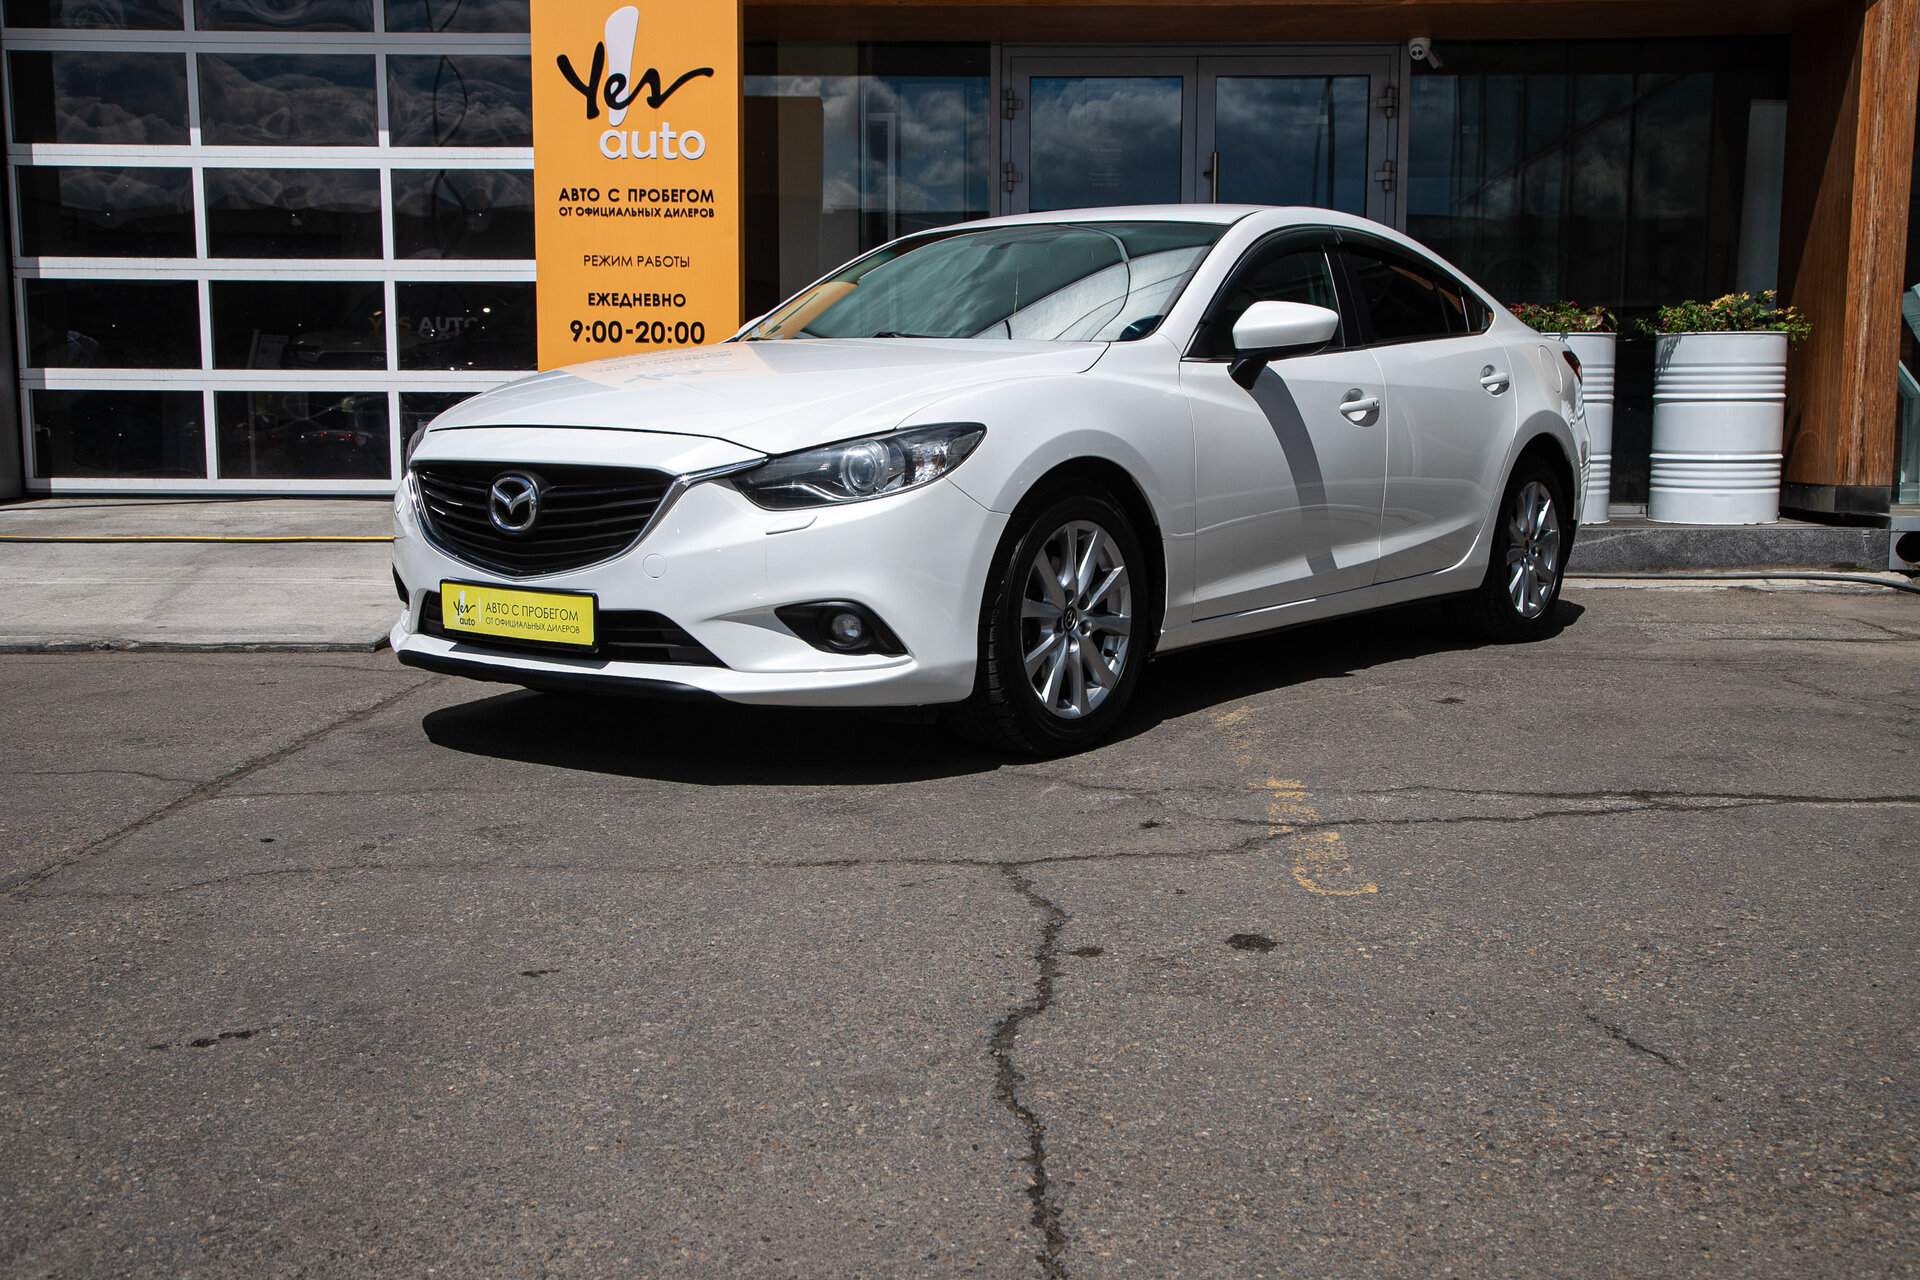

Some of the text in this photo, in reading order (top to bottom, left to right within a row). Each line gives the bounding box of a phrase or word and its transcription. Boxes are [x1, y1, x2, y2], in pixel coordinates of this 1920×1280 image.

[599, 122, 706, 160] auto
[559, 188, 714, 203] АВТО С ПРОБЕГОМ
[559, 206, 714, 218] ОТ ОФИЦИАЛЬНЫХ ДИЛЕРОВ
[583, 254, 690, 267] РЕЖИМ РАБОТЫ
[588, 292, 686, 308] ЕЖЕДНЕВНО
[570, 320, 705, 344] 9:00-20:00
[485, 602, 579, 622] АВТО С ПРОБЕГОМ
[459, 617, 476, 626] auto
[485, 617, 580, 634] ОТ ОФИЦИАЛЬНЫХ ДИЛЕРОВ
